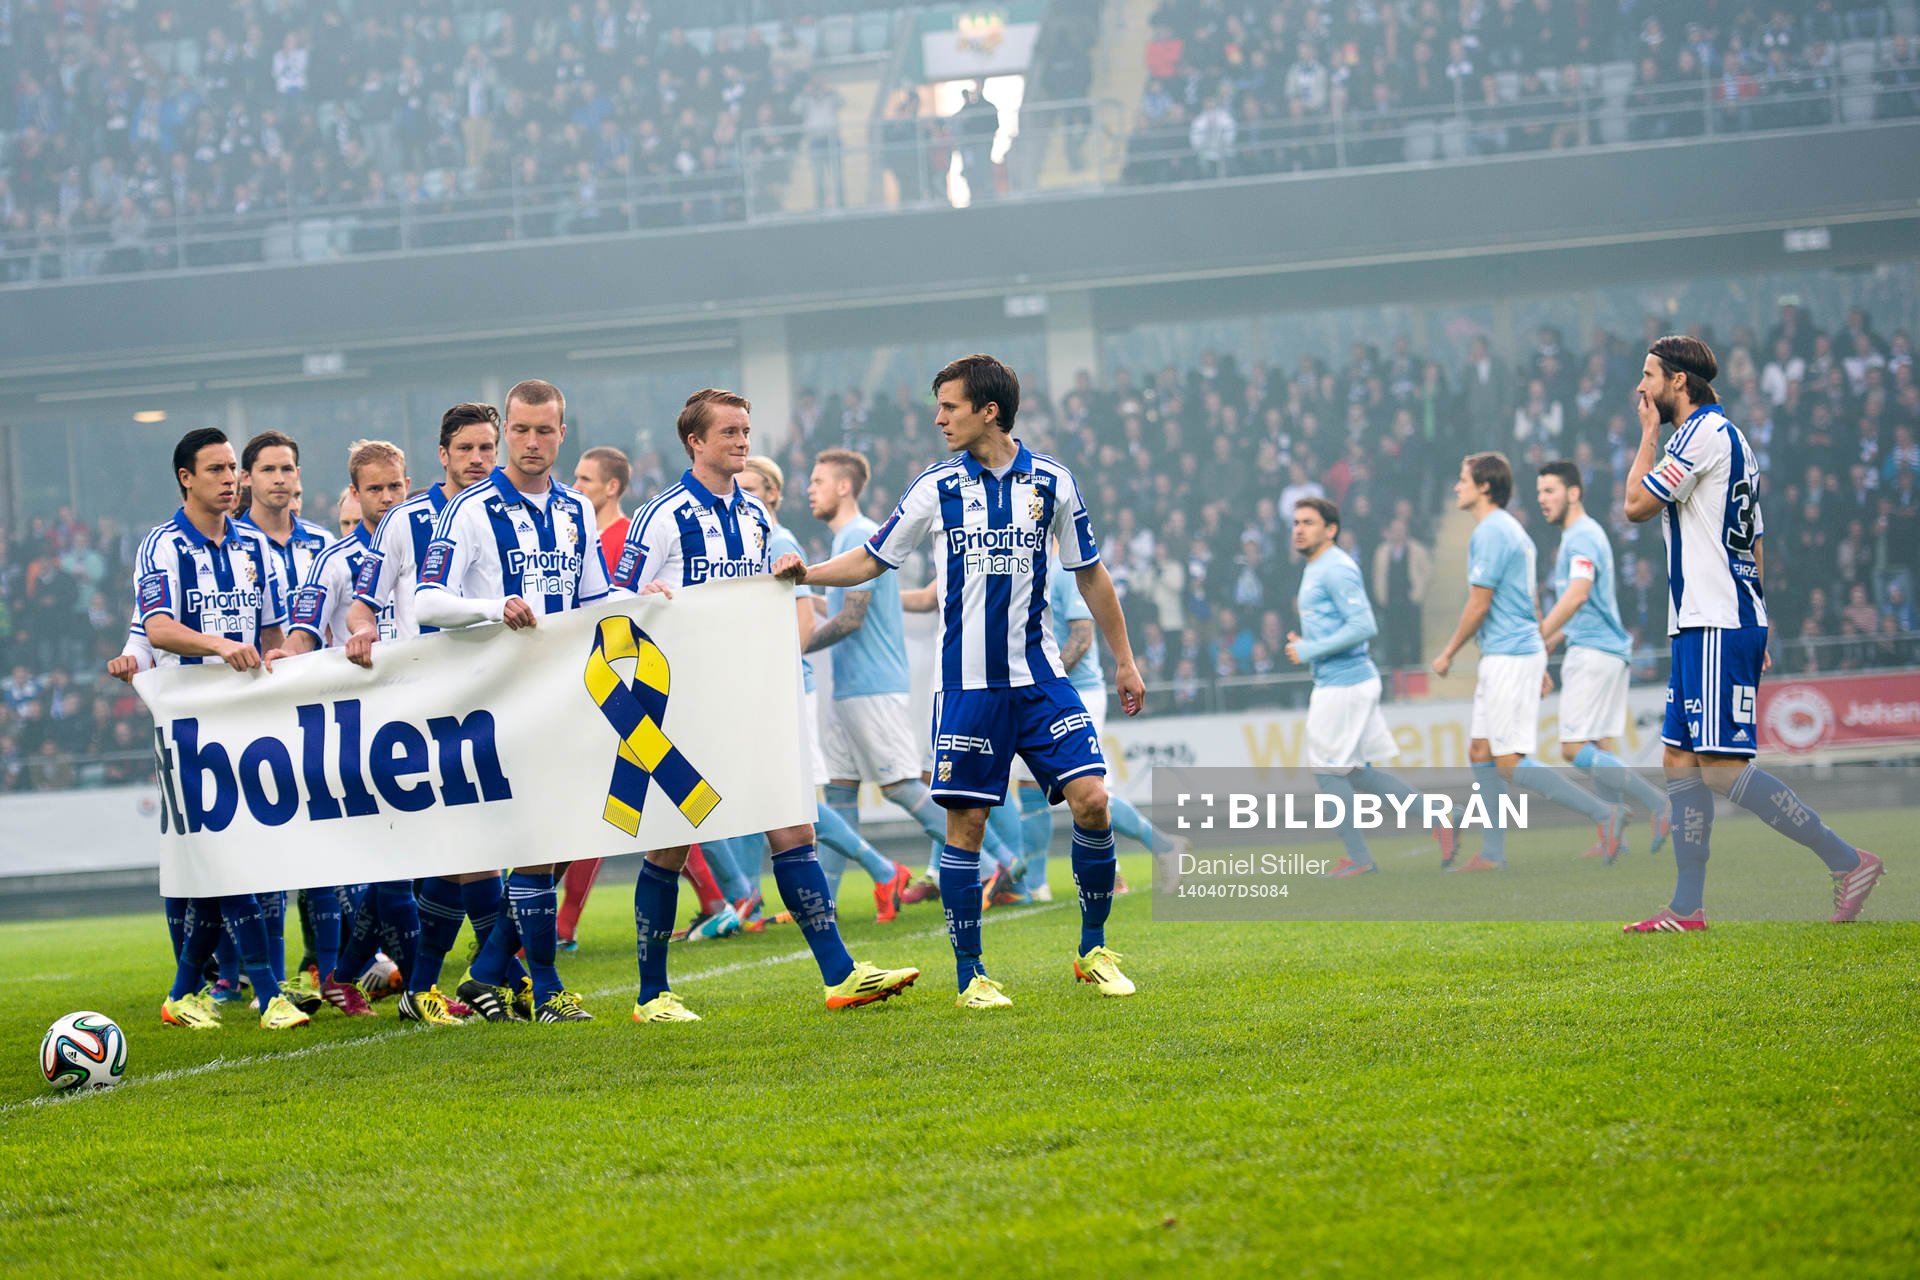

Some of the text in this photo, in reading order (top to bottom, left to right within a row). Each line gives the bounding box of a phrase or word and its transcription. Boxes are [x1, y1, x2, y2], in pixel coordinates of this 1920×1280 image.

[950, 525, 1045, 554] Prioritet
[508, 550, 582, 575] Prioritet
[692, 556, 763, 581] Priorite
[965, 553, 1030, 576] Finans
[187, 586, 262, 613] Prioritet
[202, 613, 255, 633] Finans
[1049, 712, 1093, 740] SEF
[937, 734, 994, 755] SEFA
[156, 698, 512, 836] tbollen
[234, 913, 261, 927] IFK
[317, 912, 340, 920] IFK
[521, 908, 556, 916] IFK
[797, 887, 830, 932] SKF
[636, 906, 650, 961] SKF
